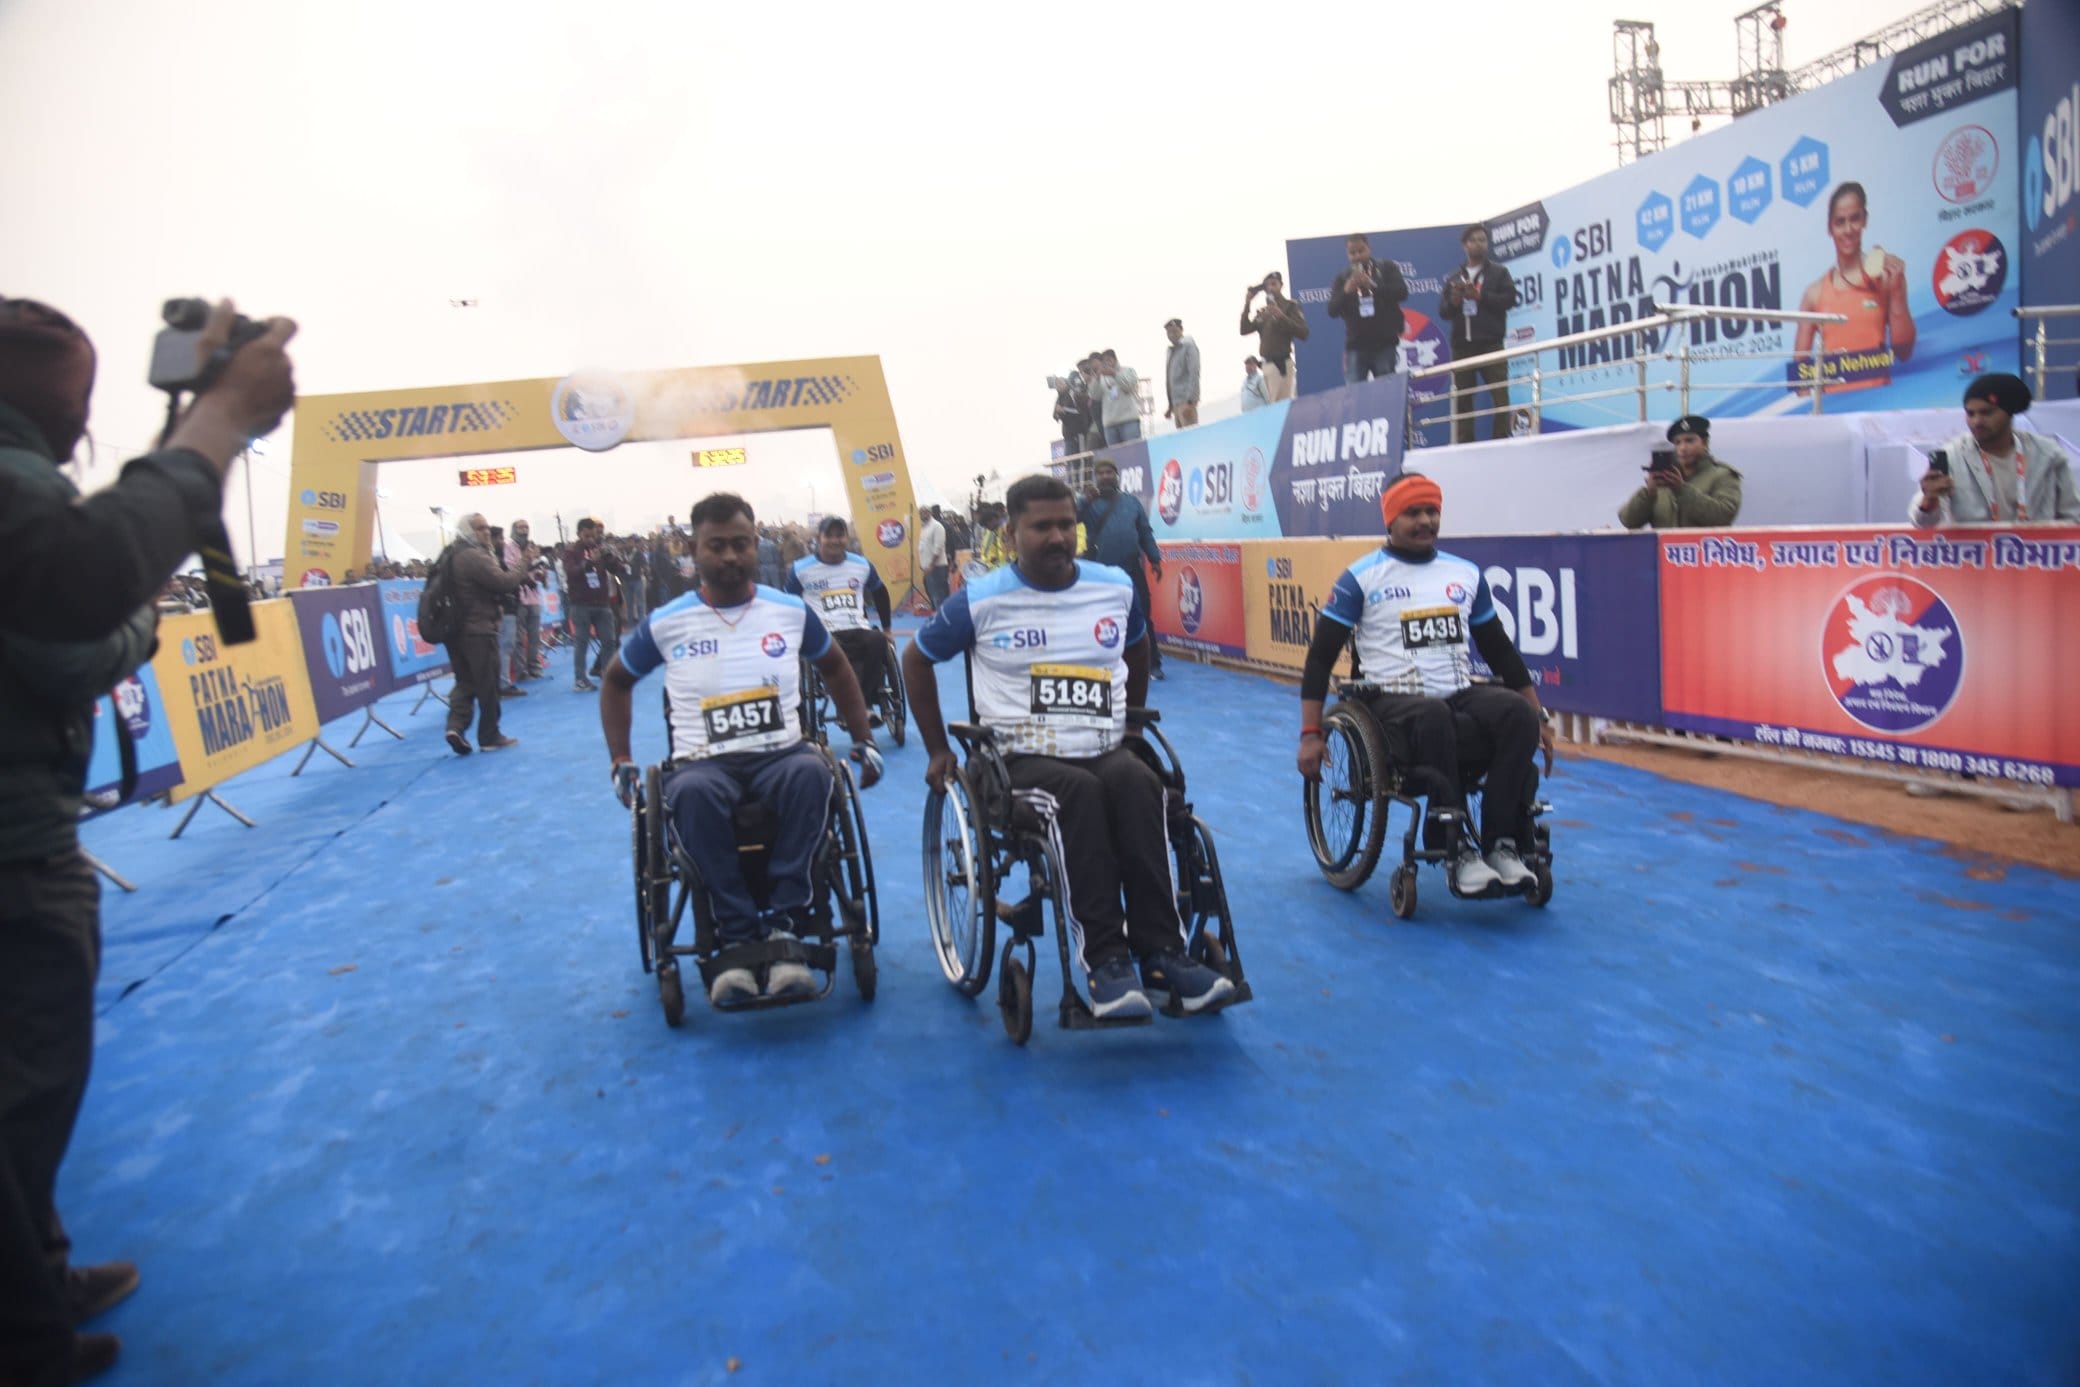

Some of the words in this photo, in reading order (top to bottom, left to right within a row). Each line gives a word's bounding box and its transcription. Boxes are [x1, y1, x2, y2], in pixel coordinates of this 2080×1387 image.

[1897, 55, 1949, 93] RUN
[1954, 32, 2006, 72] FOR
[2043, 82, 2080, 218] SBI
[1491, 222, 1516, 244] RUN
[1516, 213, 1541, 235] FOR
[1574, 219, 1613, 262] SBI
[1515, 273, 1543, 308] SBI
[1555, 255, 1645, 315] PATNA
[1798, 361, 1839, 379] Sana
[1840, 350, 1895, 373] Nehwal
[720, 377, 808, 412] START
[375, 403, 475, 439] START
[867, 443, 895, 462] SBI
[1291, 426, 1338, 468] RUN
[1340, 417, 1390, 461] FOR
[1120, 466, 1144, 493] FOR
[1204, 461, 1234, 505] SBI
[1291, 478, 1316, 508] नशा
[1346, 464, 1386, 504] बिहार
[318, 491, 347, 509] SBI
[1276, 557, 1293, 580] SBI
[1769, 541, 1840, 567] उत्पाद
[1841, 535, 1885, 568] एवं
[1887, 534, 1989, 570] निबंधन
[1268, 583, 1306, 609] PATNA
[1384, 586, 1412, 600] SBI
[1270, 607, 1314, 648] MARA
[1484, 565, 1578, 660] SBI
[195, 633, 218, 664] SBI
[340, 607, 377, 674] SBI
[688, 639, 719, 658] SBI
[1013, 629, 1047, 649] SBI
[189, 665, 239, 708] PATNA
[1038, 678, 1104, 709] 5184
[711, 700, 773, 734] 5457
[1849, 737, 1897, 762] 15545
[1919, 748, 1963, 772] 1800
[1964, 755, 2001, 777] 345
